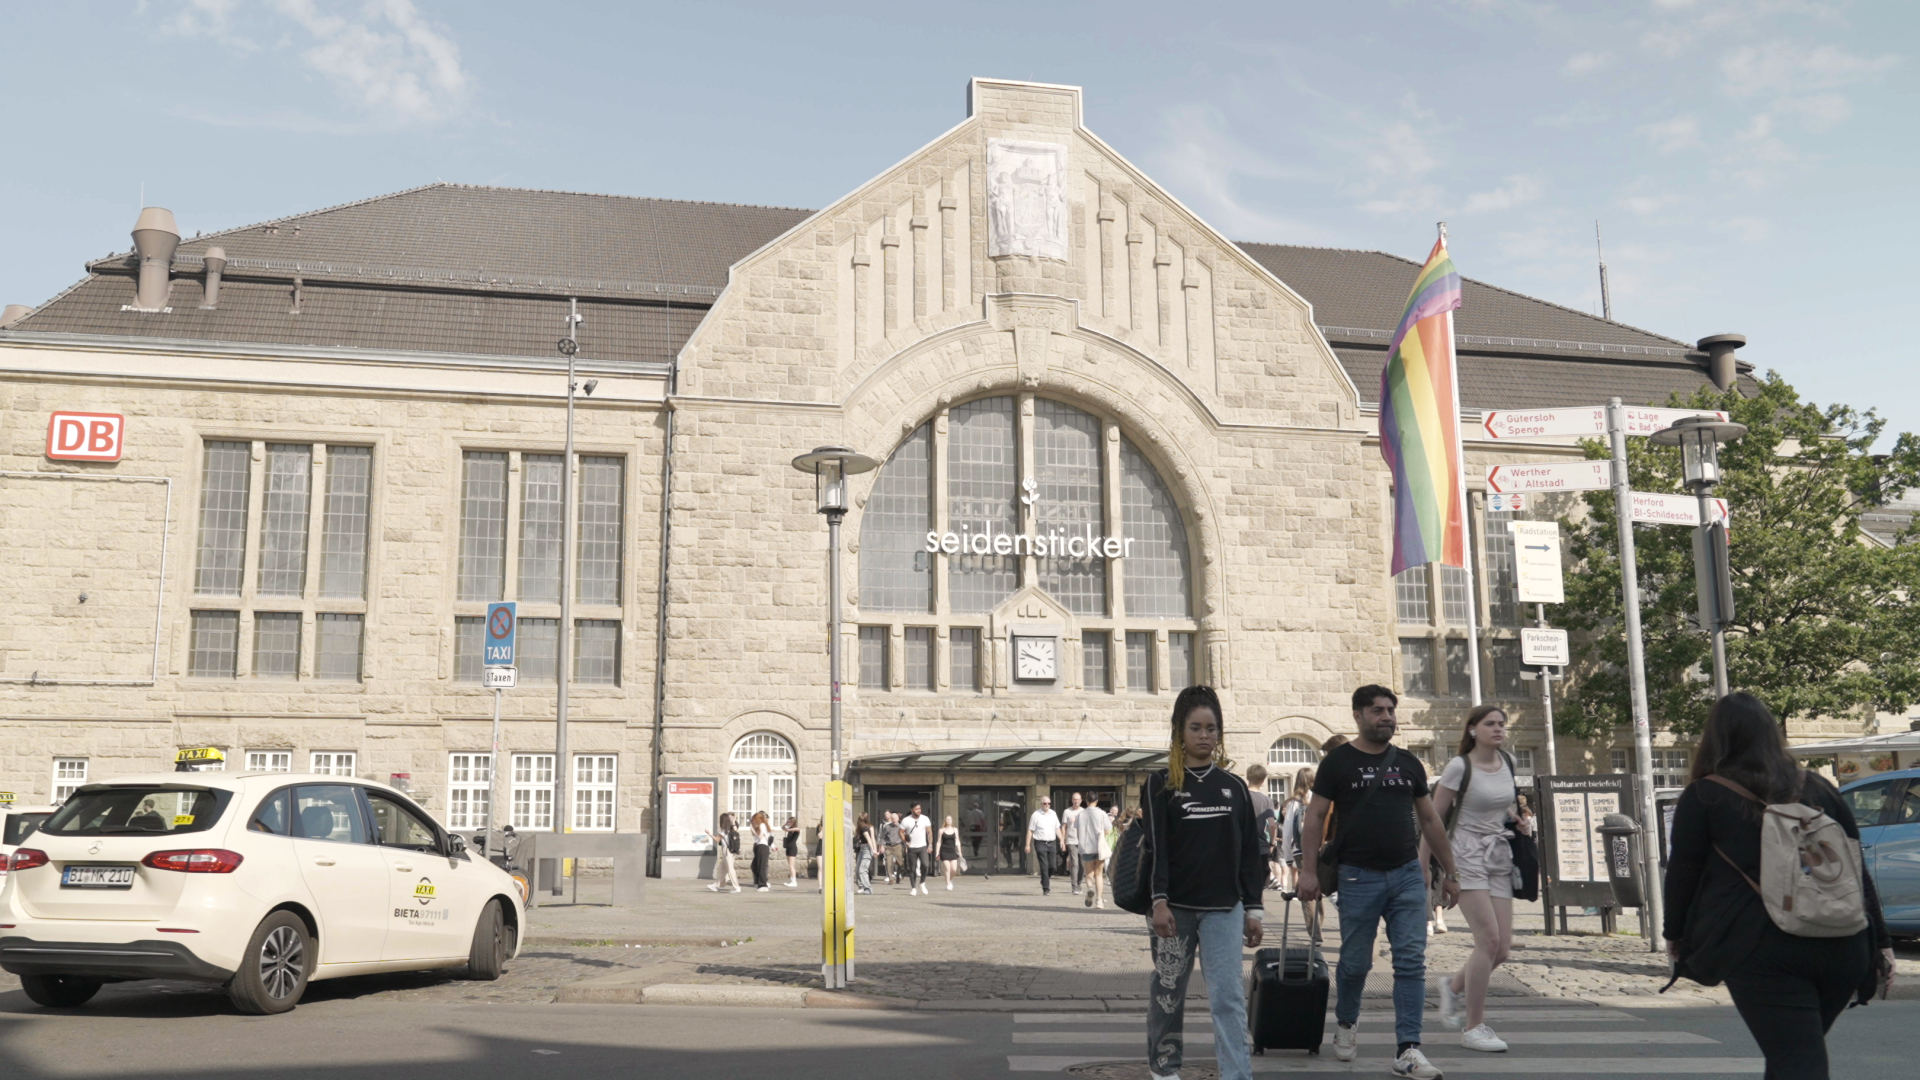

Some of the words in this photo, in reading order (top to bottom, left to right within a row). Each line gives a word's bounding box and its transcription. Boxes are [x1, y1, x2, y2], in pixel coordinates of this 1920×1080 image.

[1506, 413, 1555, 423] Gütersloh
[1593, 411, 1603, 420] 20
[1637, 411, 1659, 422] Lage
[1508, 425, 1545, 436] Spenge
[1595, 422, 1603, 431] 17
[1639, 423, 1651, 432] Bad
[57, 419, 115, 453] DB
[1510, 468, 1552, 477] Werther
[1592, 465, 1601, 474] 13
[1525, 479, 1565, 488] Altstadt
[1633, 497, 1664, 507] Herford
[1634, 508, 1694, 521] BI-Schildesche
[1519, 527, 1558, 536] Radstation
[925, 520, 1135, 558] seidensticker
[1526, 633, 1562, 642] Parkschein-
[487, 646, 511, 660] TAXI
[1533, 644, 1558, 652] automat
[490, 672, 511, 682] Taxen
[180, 749, 207, 760] TAXI
[1558, 798, 1581, 806] SUMMER
[1592, 798, 1615, 806] SUMMER
[1186, 805, 1232, 813] FORMIDABLE
[174, 815, 191, 823] 271
[70, 868, 84, 882] BI
[91, 868, 107, 882] MK
[108, 868, 132, 883] 210
